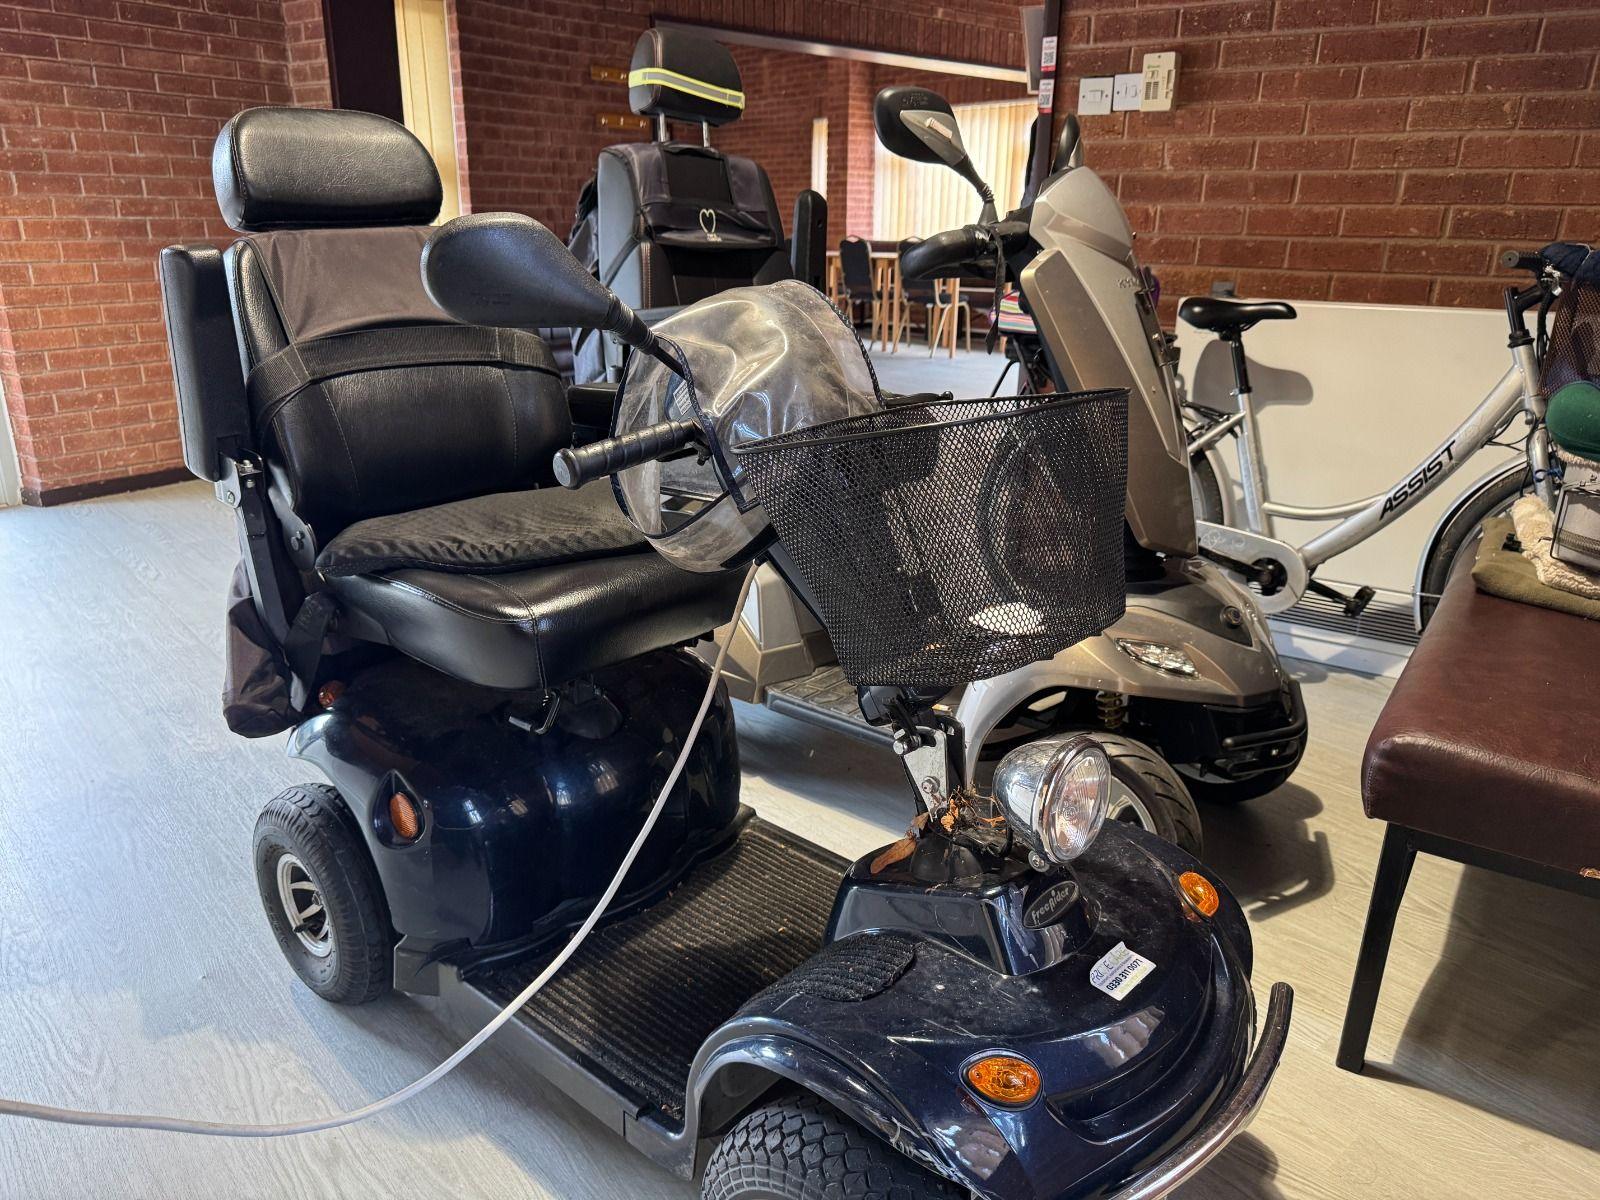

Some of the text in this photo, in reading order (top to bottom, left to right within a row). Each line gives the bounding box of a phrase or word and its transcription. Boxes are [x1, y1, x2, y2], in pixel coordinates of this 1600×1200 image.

[1379, 439, 1456, 521] ASSIST
[1105, 976, 1123, 991] 0330
[1118, 968, 1131, 980] 311
[1126, 957, 1143, 972] 0071
